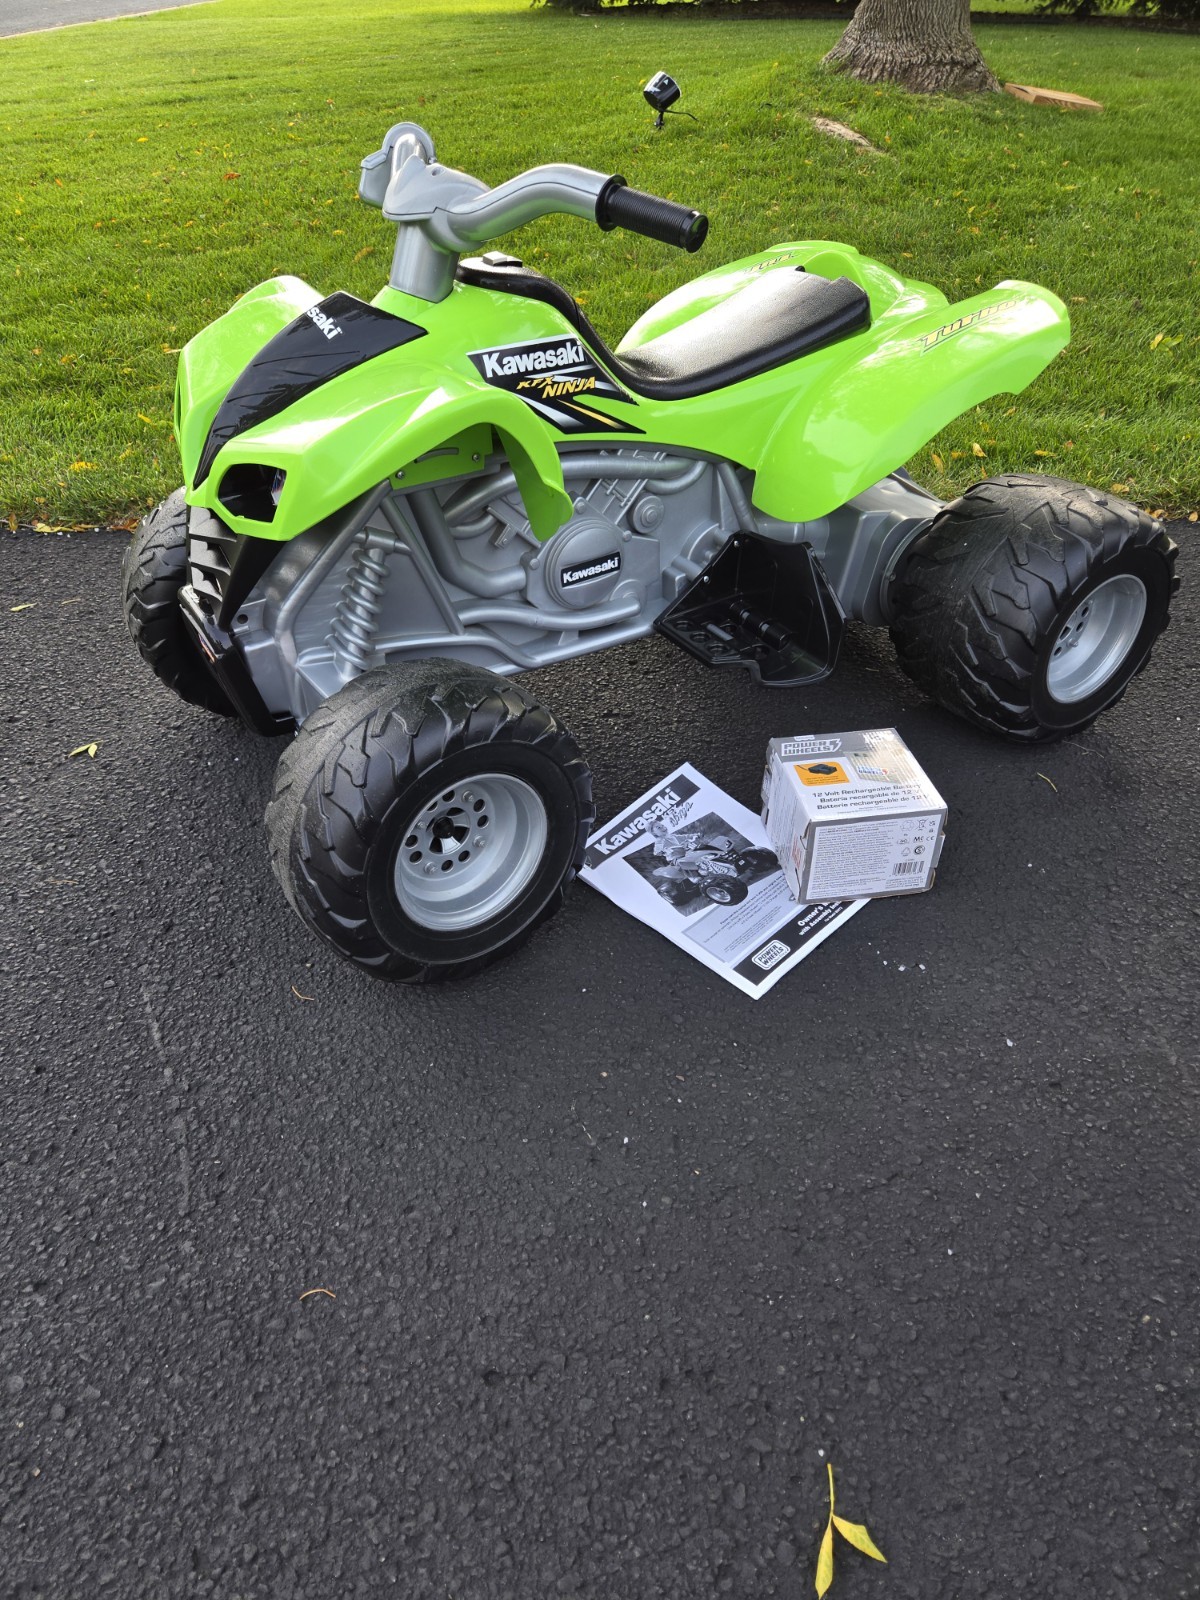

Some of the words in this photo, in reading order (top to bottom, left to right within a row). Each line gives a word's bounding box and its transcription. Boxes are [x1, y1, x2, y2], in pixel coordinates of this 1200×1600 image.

[307, 306, 342, 340] saki
[482, 341, 585, 378] Kawasaki
[516, 375, 555, 389] KFX
[542, 376, 596, 399] NINJA
[563, 557, 619, 583] Kawasaki
[783, 741, 828, 749] POWER
[783, 746, 831, 754] WHEELS
[841, 786, 891, 795] Rechargeable
[593, 786, 681, 855] Kawasaki
[797, 905, 823, 926] Owner's
[758, 944, 778, 961] POWER
[763, 947, 783, 965] WHEELS
